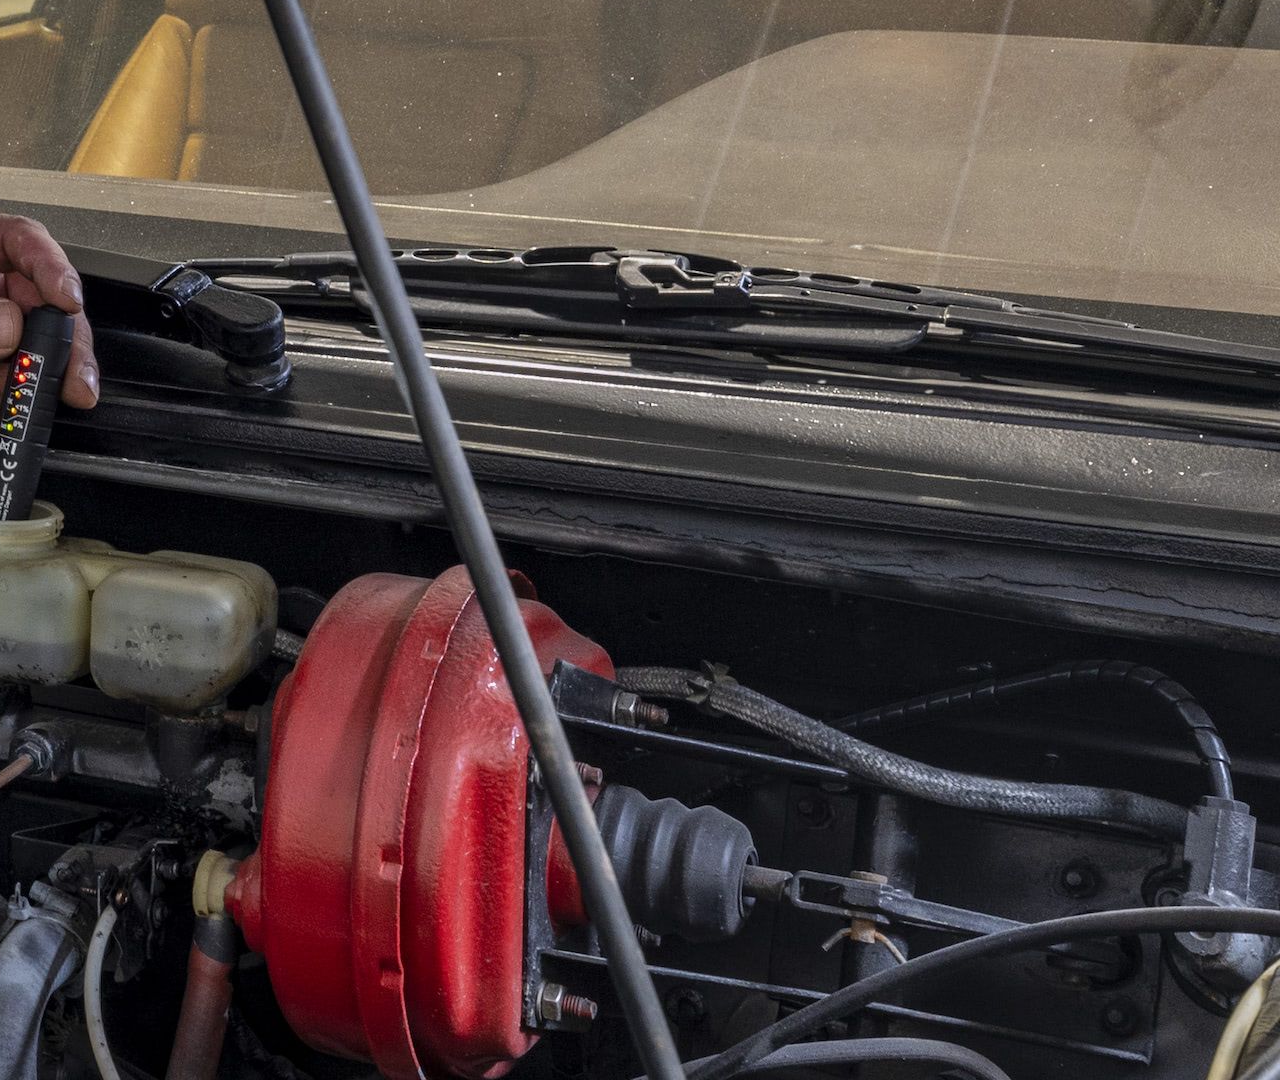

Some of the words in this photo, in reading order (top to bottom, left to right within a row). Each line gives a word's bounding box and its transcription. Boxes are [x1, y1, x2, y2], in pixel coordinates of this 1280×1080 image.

[19, 388, 33, 397] <2%
[15, 404, 29, 413] <1%
[13, 420, 23, 429] 0%
